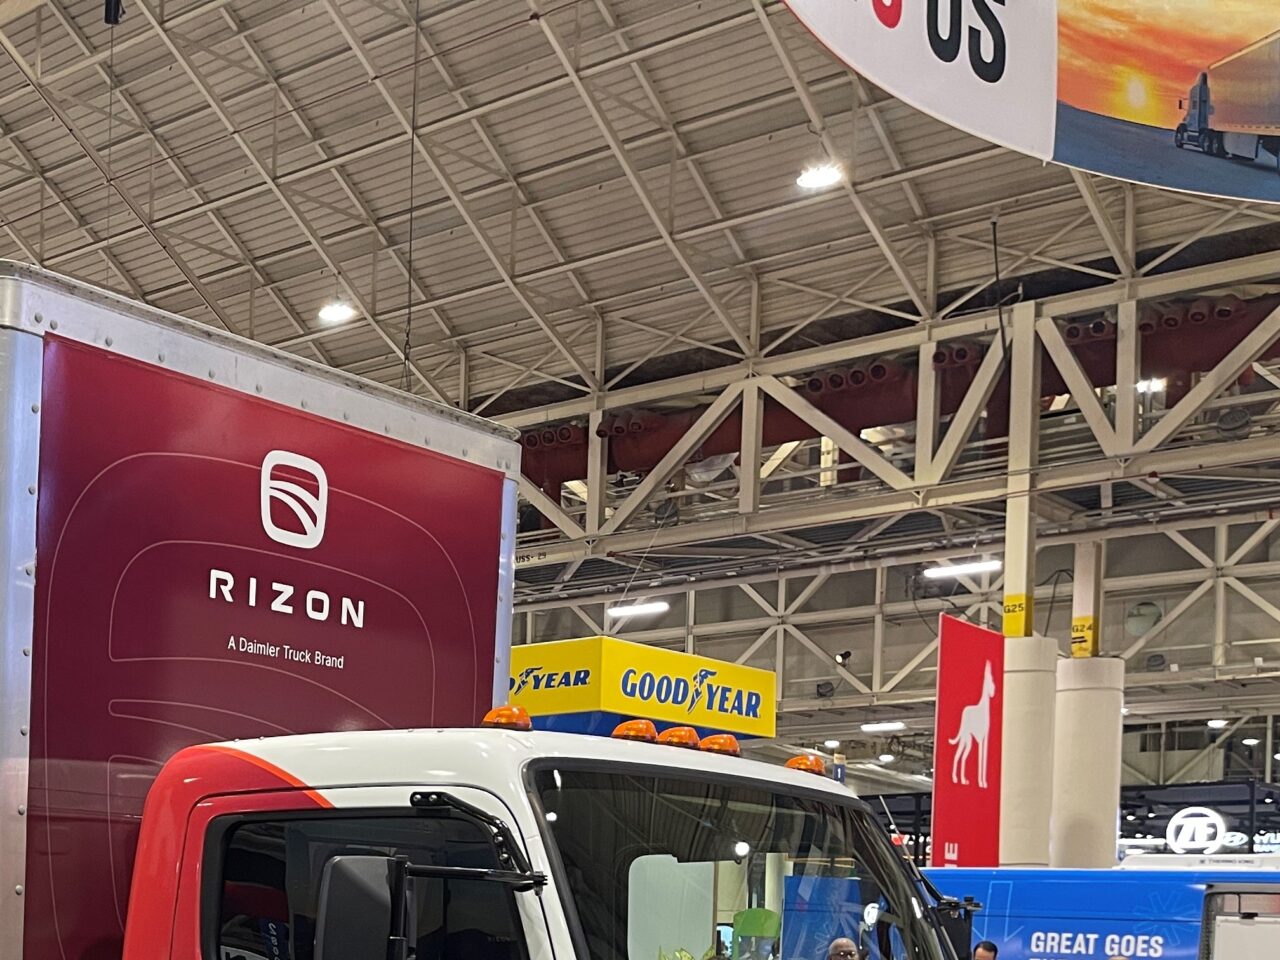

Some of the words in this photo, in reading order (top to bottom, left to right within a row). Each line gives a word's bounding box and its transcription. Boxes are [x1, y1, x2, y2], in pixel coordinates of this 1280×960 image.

[209, 568, 365, 628] RIZON
[1003, 603, 1025, 613] G25
[227, 635, 237, 650] A
[239, 637, 280, 658] Daimler
[283, 645, 312, 663] Truck
[314, 650, 345, 669] Brand
[1031, 932, 1099, 955] GREAT
[1105, 934, 1164, 958] GOES
